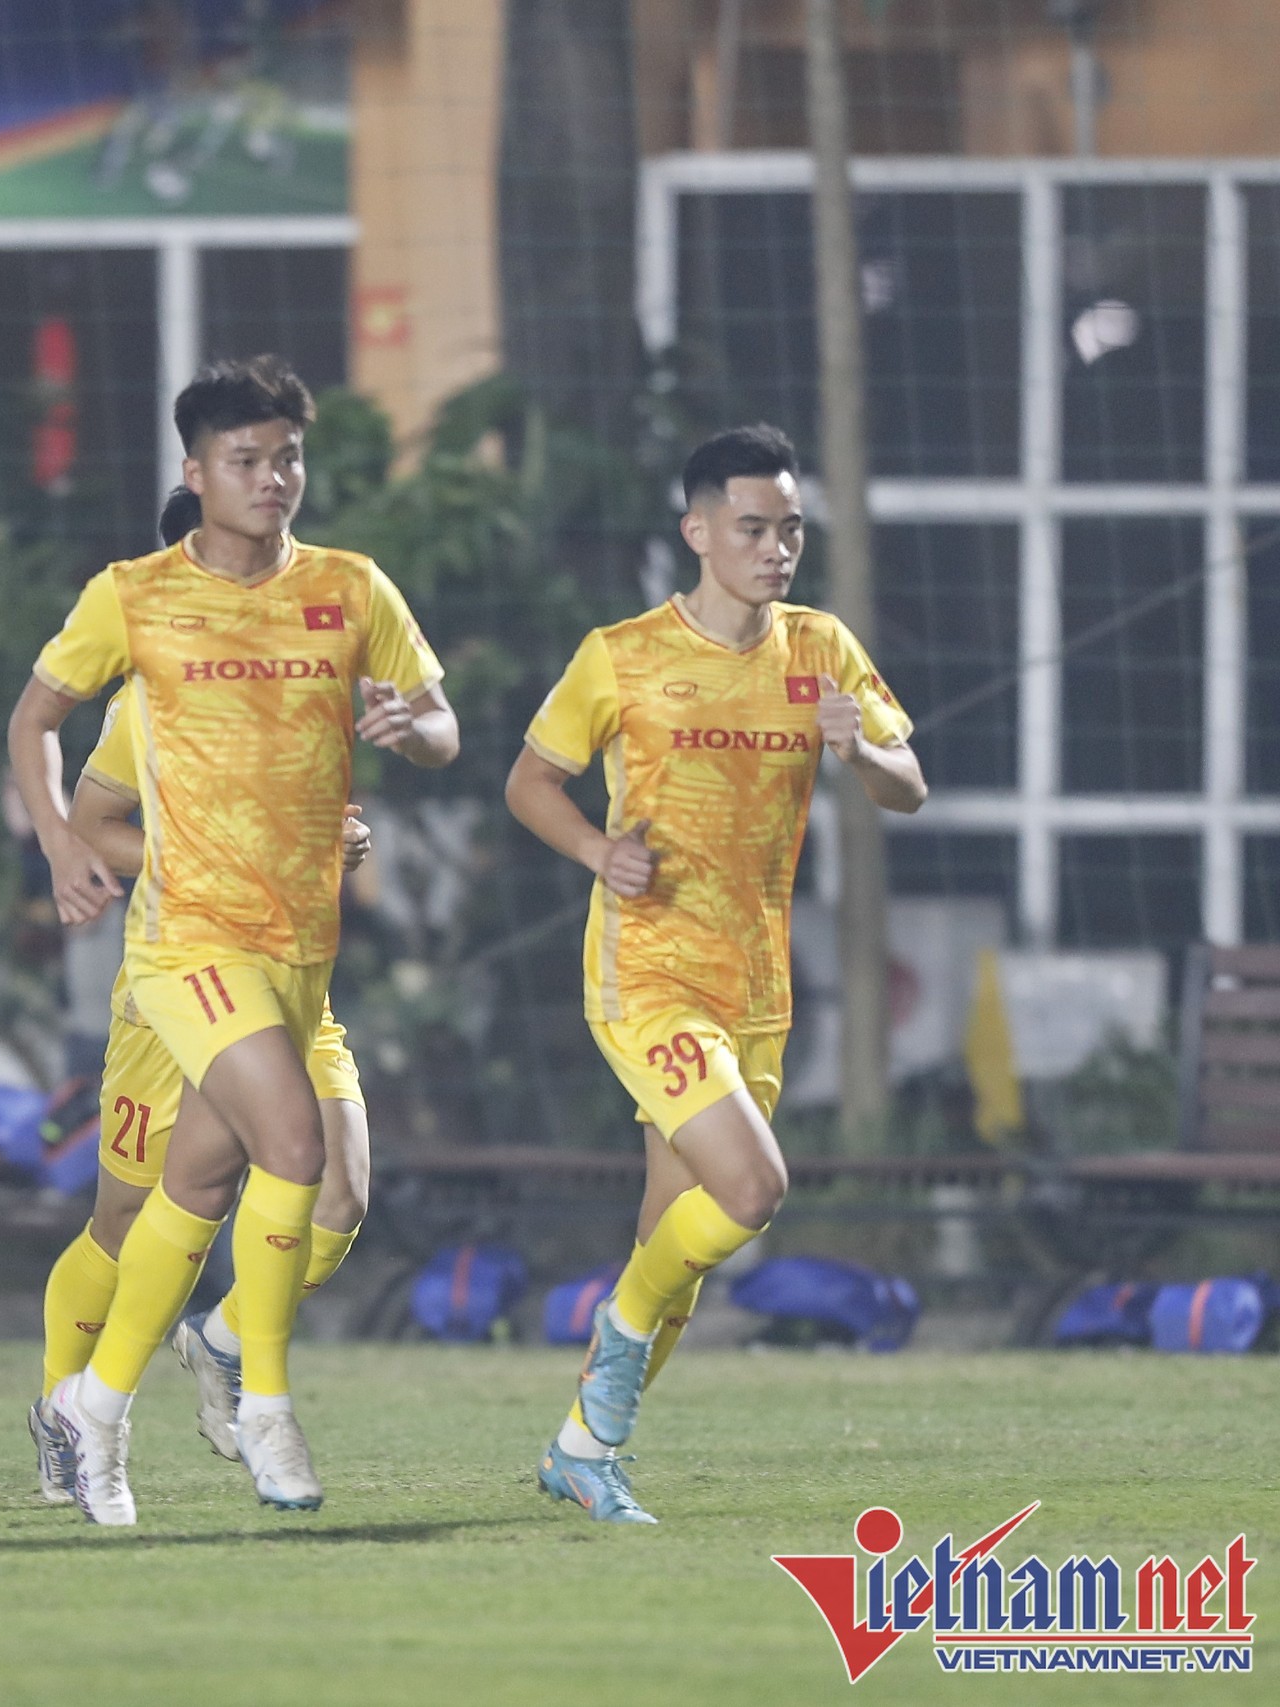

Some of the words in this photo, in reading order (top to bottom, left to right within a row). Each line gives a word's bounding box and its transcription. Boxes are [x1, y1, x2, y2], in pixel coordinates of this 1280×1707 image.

[182, 658, 337, 682] HONDA
[670, 727, 811, 752] HONDA
[183, 964, 236, 1025] 11
[646, 1031, 707, 1098] 39
[110, 1095, 152, 1163] 21
